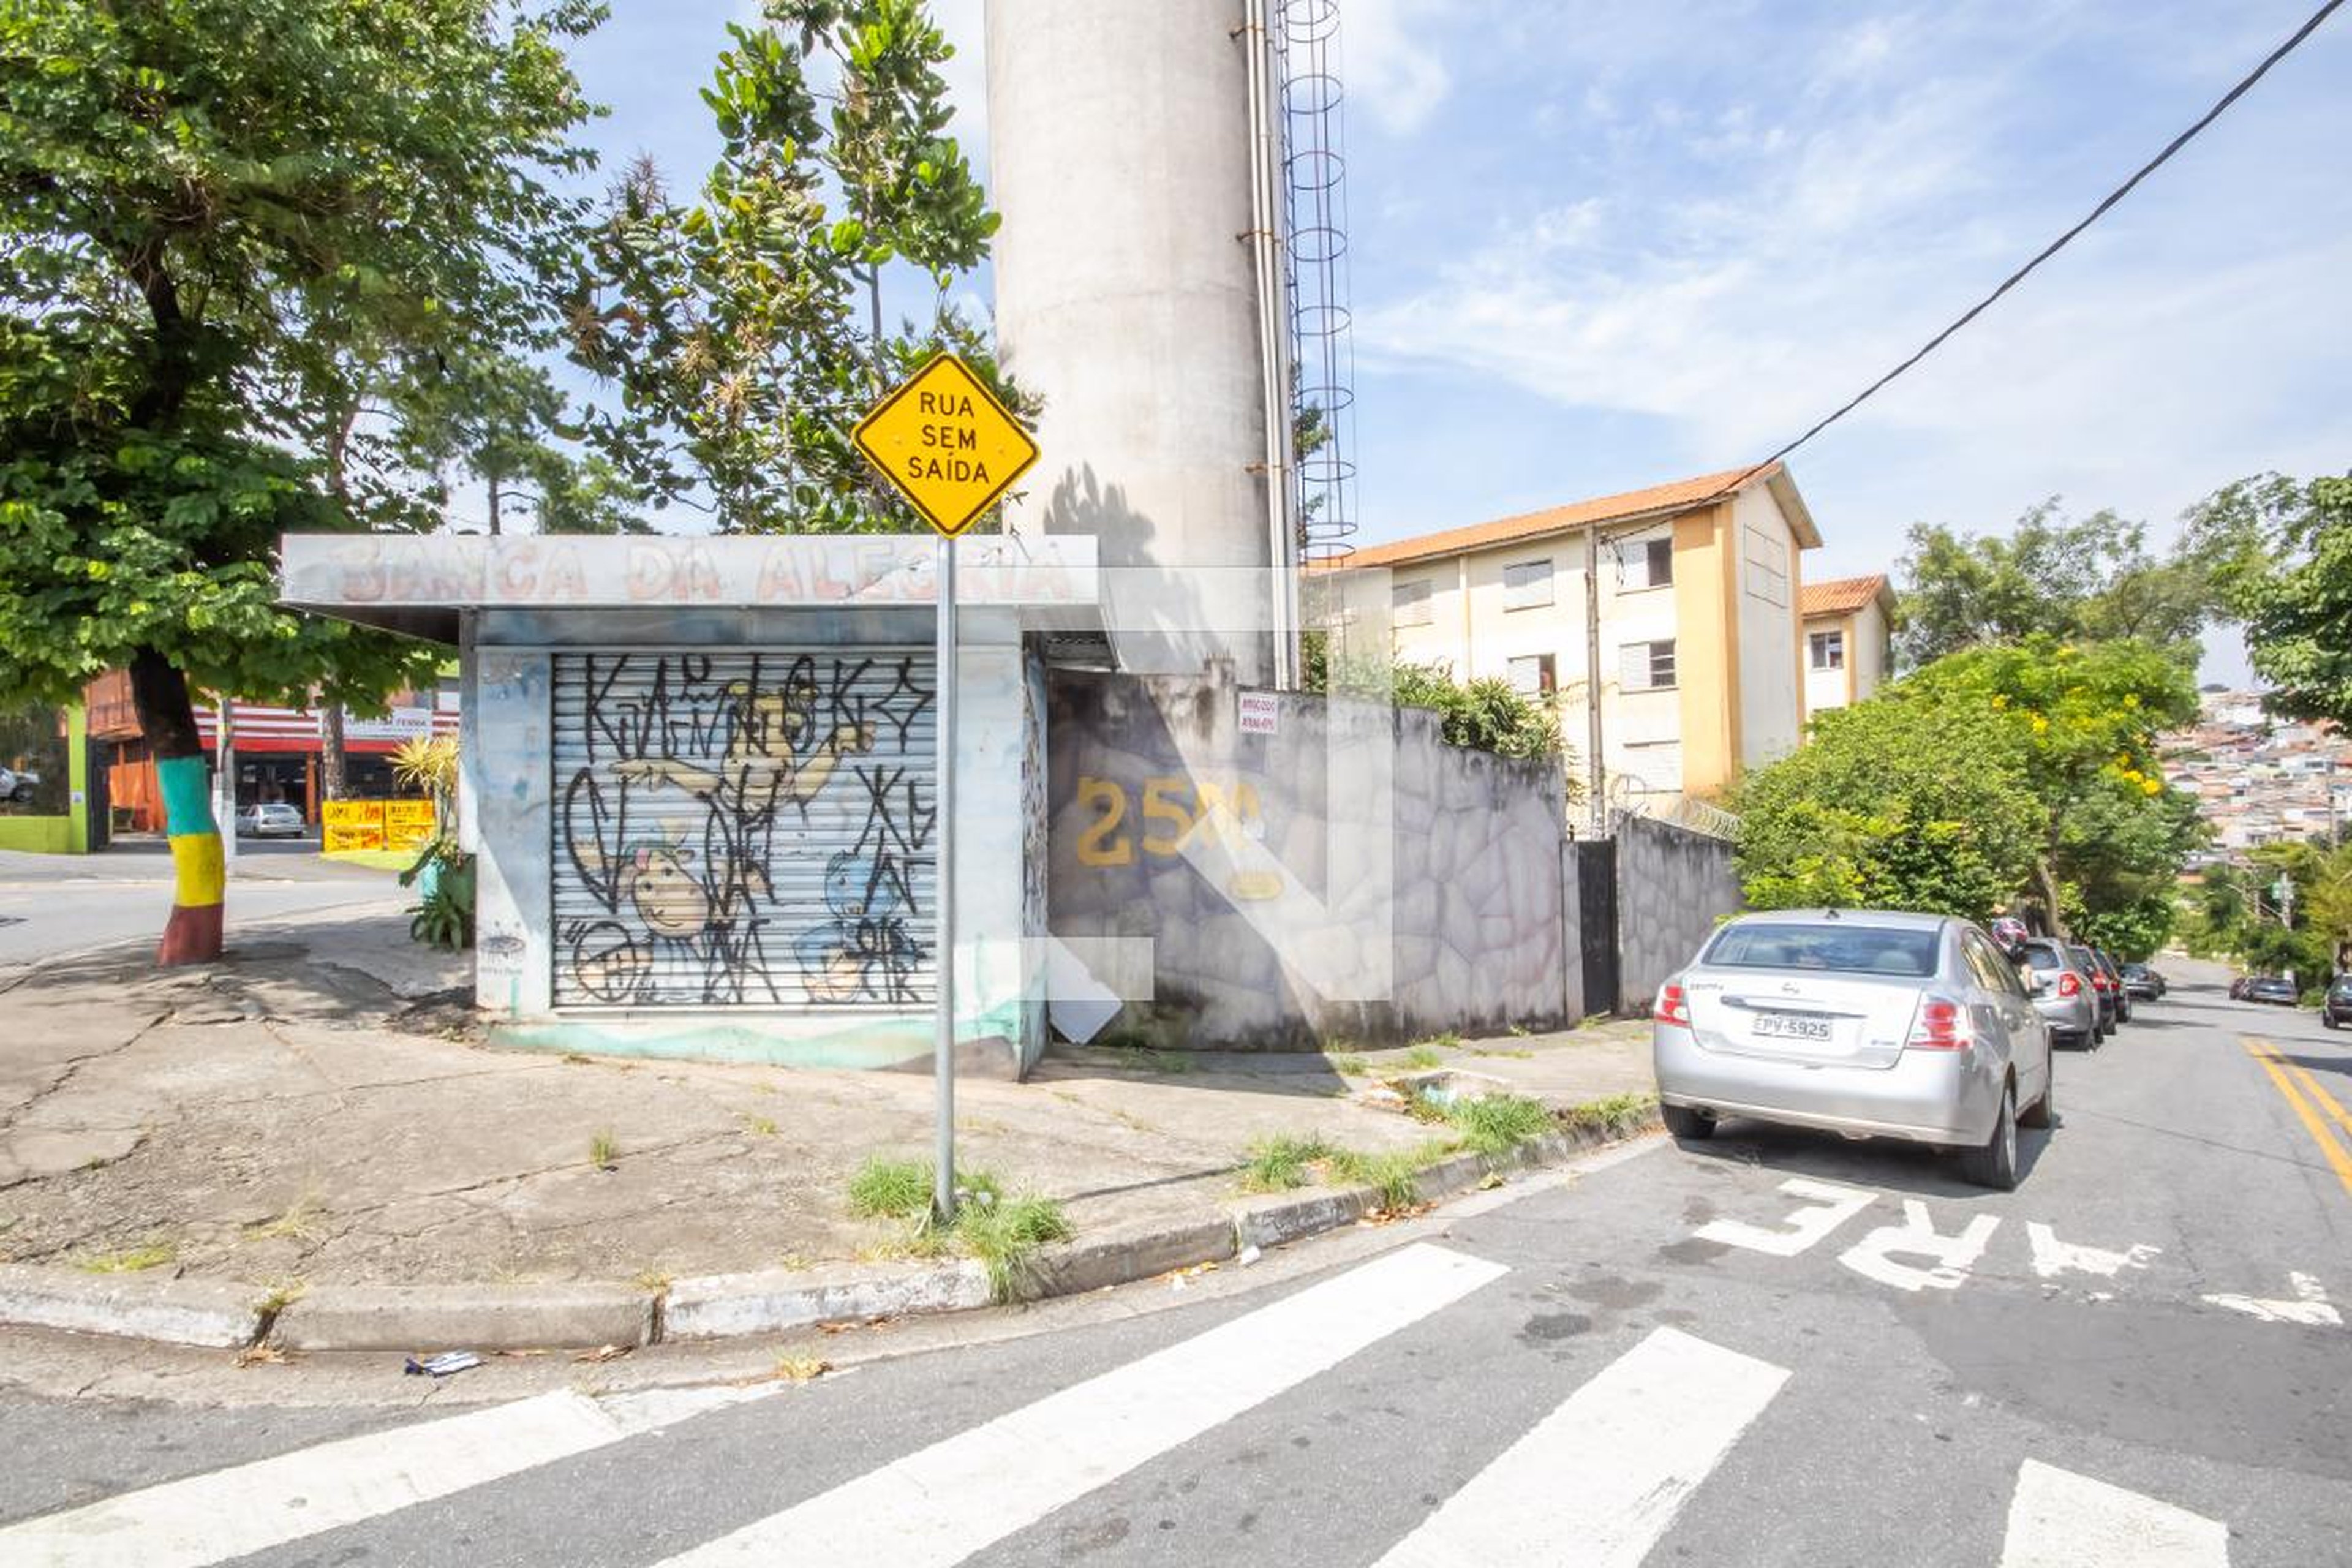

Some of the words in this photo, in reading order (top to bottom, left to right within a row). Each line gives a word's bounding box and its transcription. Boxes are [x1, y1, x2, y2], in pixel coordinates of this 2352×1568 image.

[919, 391, 975, 418] RUA
[921, 424, 976, 450] SEM
[908, 451, 990, 484] SAÍDA
[334, 539, 589, 601] BANCA
[623, 542, 720, 600] DA
